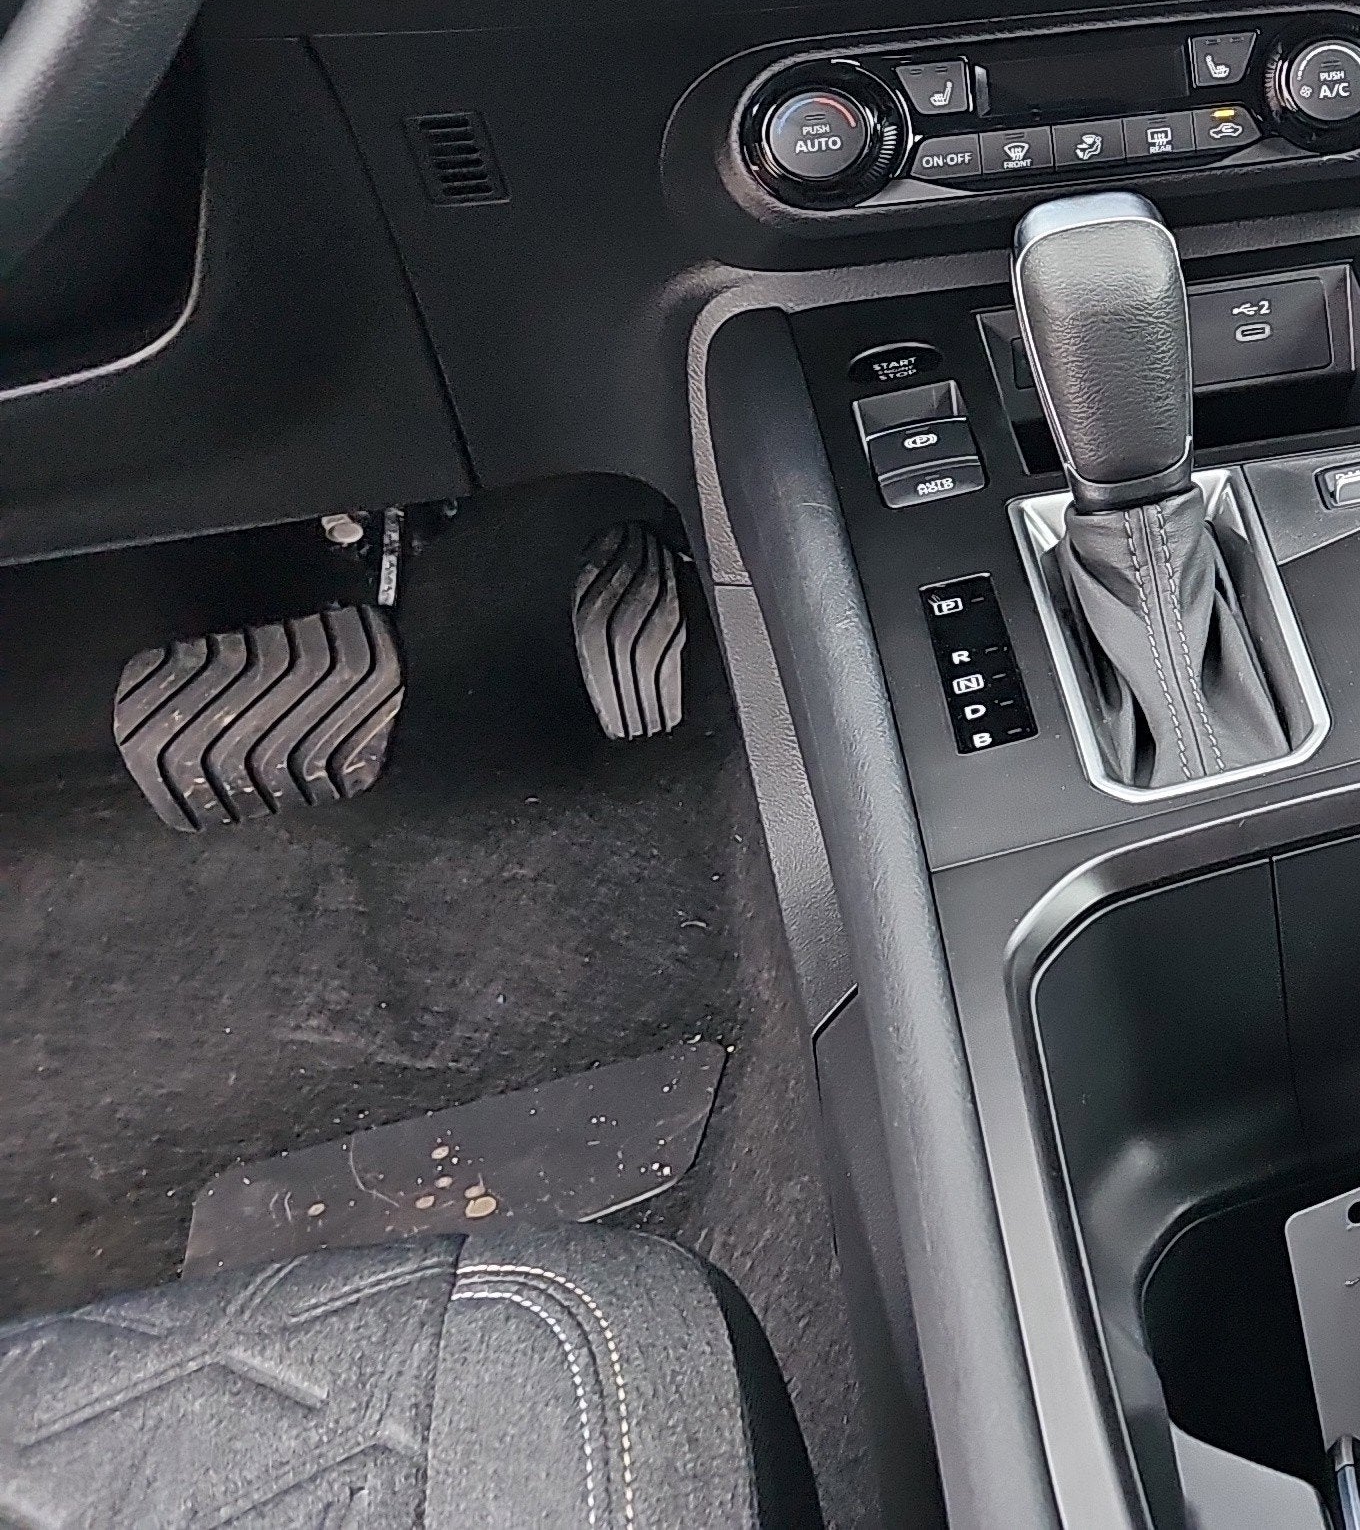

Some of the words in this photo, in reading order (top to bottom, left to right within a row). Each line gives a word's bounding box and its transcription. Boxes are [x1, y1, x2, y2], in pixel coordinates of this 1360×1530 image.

[1319, 71, 1345, 82] PUSH
[1319, 82, 1350, 99] A/C
[802, 124, 830, 136] PUSH
[795, 136, 842, 154] AUTO
[1149, 144, 1172, 154] REAR
[1003, 159, 1033, 169] FRONT
[872, 356, 917, 370] START
[878, 369, 917, 381] STOP
[916, 478, 953, 490] AUTO
[952, 650, 971, 665] R
[964, 704, 986, 720] D
[972, 732, 992, 748] B
